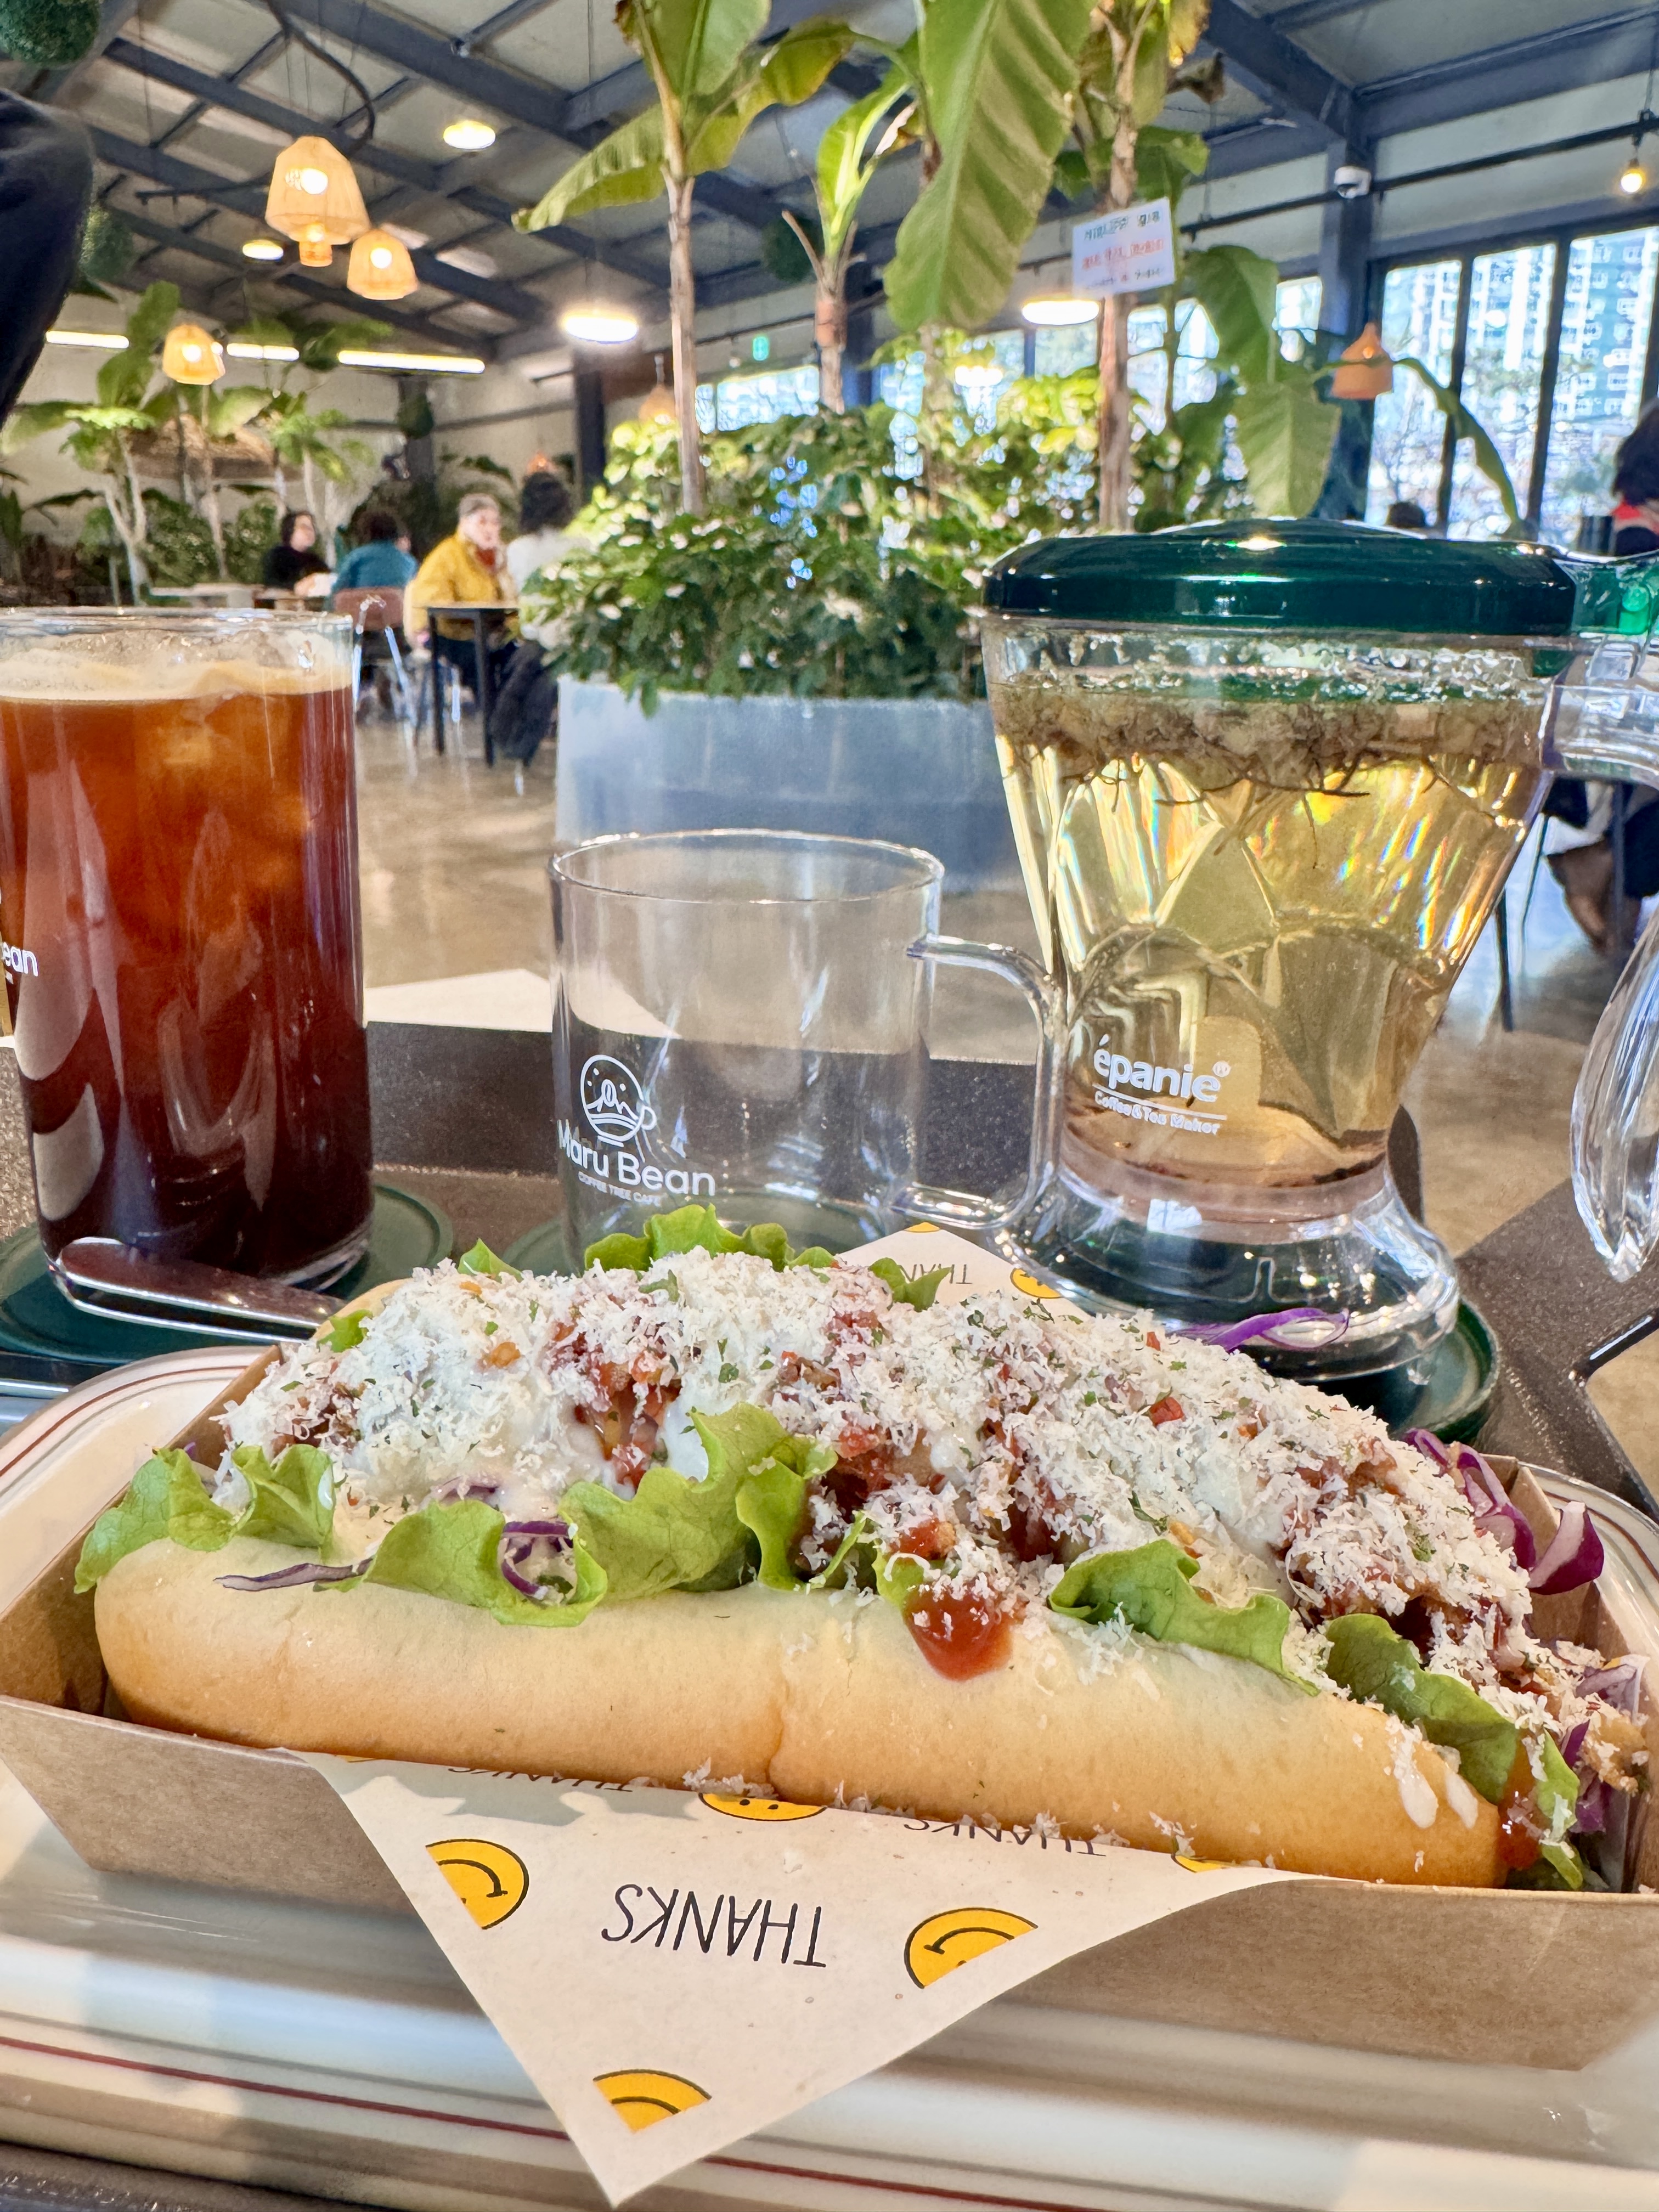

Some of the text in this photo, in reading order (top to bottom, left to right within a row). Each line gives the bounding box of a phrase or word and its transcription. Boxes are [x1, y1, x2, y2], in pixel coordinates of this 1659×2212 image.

[3, 941, 38, 977] ean
[1170, 1114, 1221, 1135] Maker
[618, 1151, 715, 1196] Bean
[601, 1883, 827, 1968] THANKS
